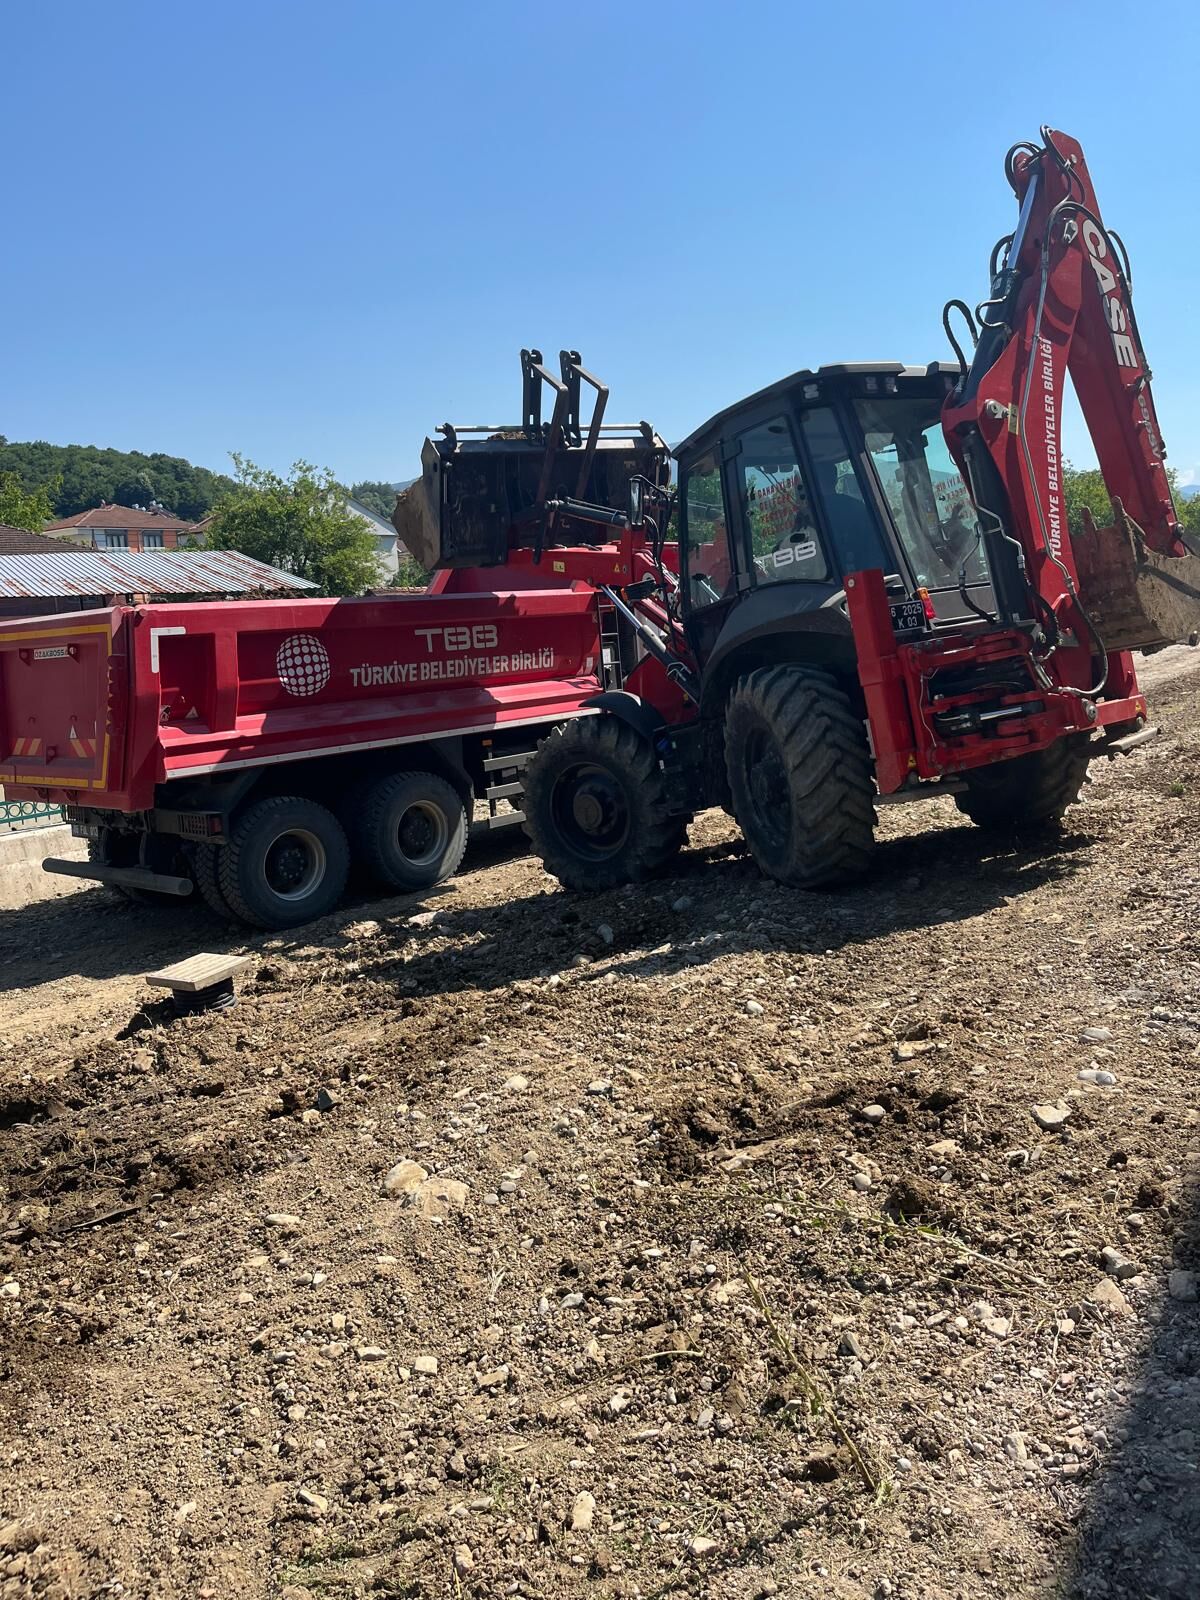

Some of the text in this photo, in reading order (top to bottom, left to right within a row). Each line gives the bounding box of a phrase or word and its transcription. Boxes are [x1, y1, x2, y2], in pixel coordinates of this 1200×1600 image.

[1083, 219, 1137, 368] CASE
[1040, 338, 1062, 556] TÜRKİYE BELEDİYELER BİRLİĞİ
[903, 603, 922, 616] 2025
[907, 616, 918, 627] 03
[350, 647, 554, 687] TÜRKİYE BELEDİYELER BİRLİĞİ
